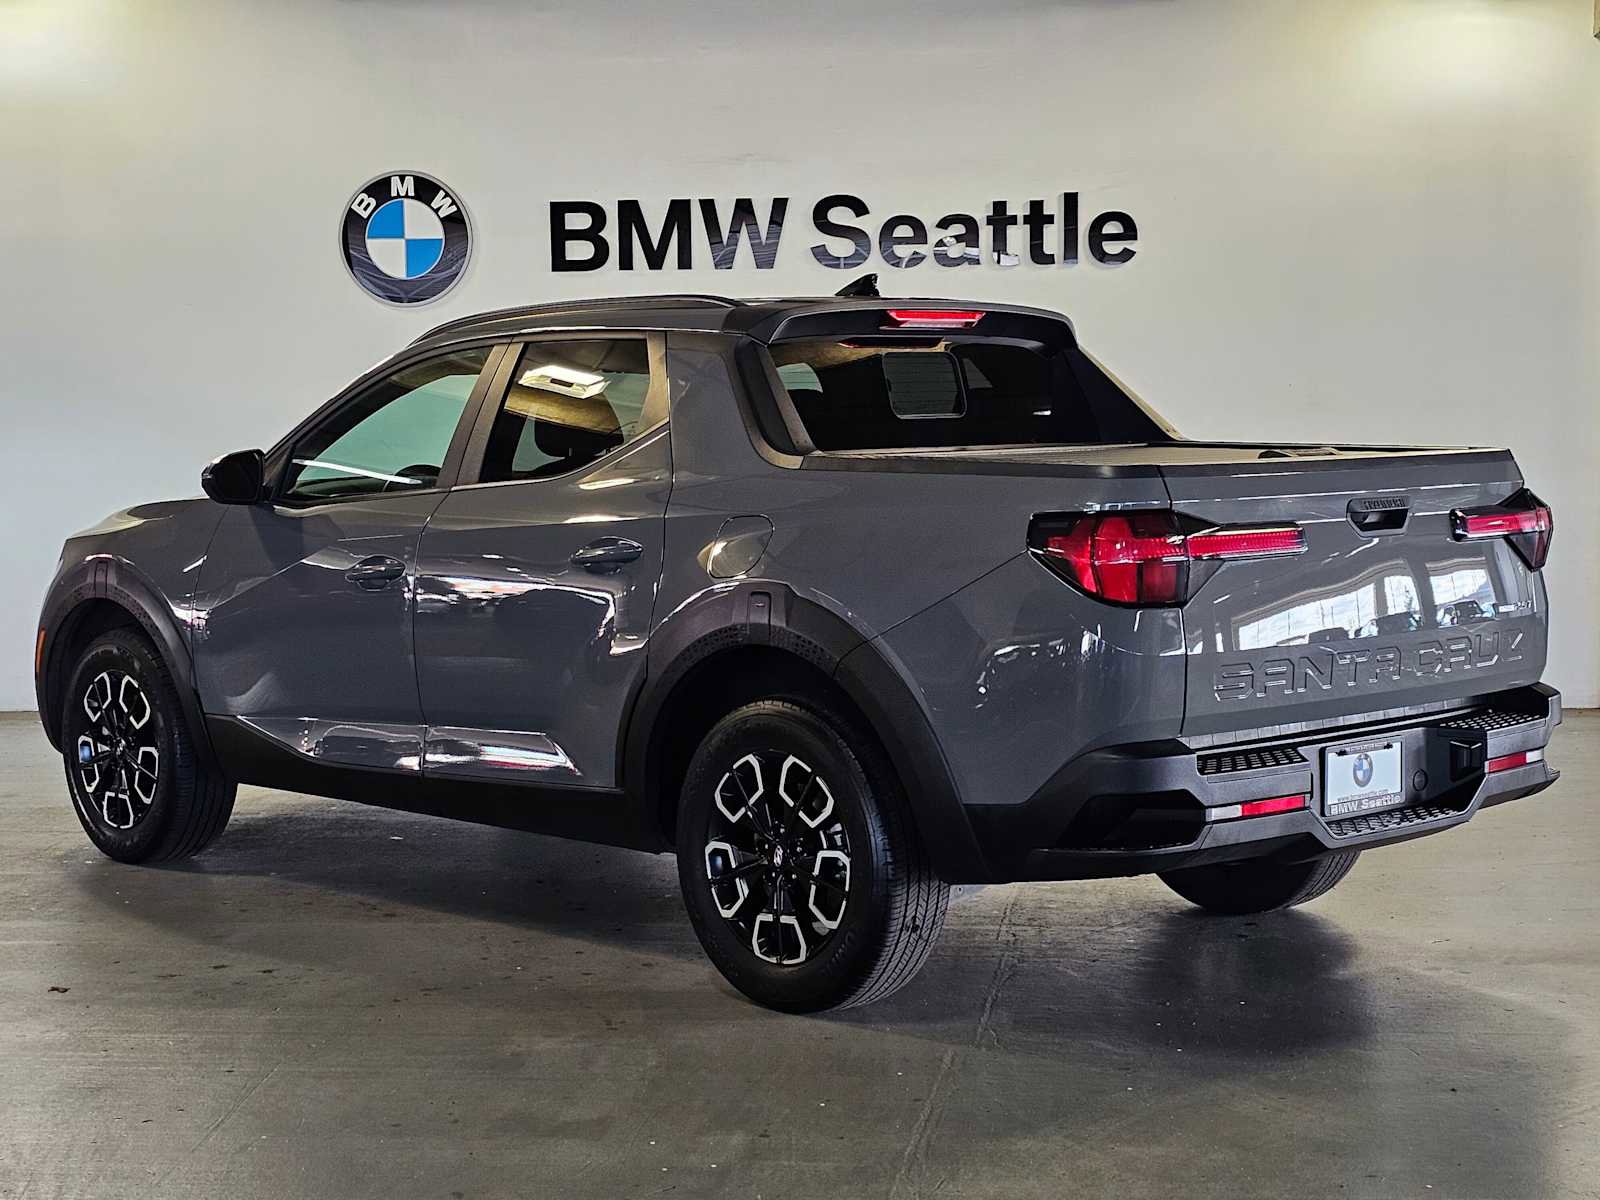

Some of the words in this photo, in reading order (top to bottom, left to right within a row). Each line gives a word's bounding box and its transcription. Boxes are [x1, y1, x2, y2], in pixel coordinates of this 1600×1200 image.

[351, 176, 457, 219] BMW
[549, 197, 789, 272] BMW
[810, 192, 1138, 269] Seattle
[1213, 646, 1401, 701] SANTA
[1416, 628, 1523, 677] CRUZ
[1331, 800, 1358, 816] BMW
